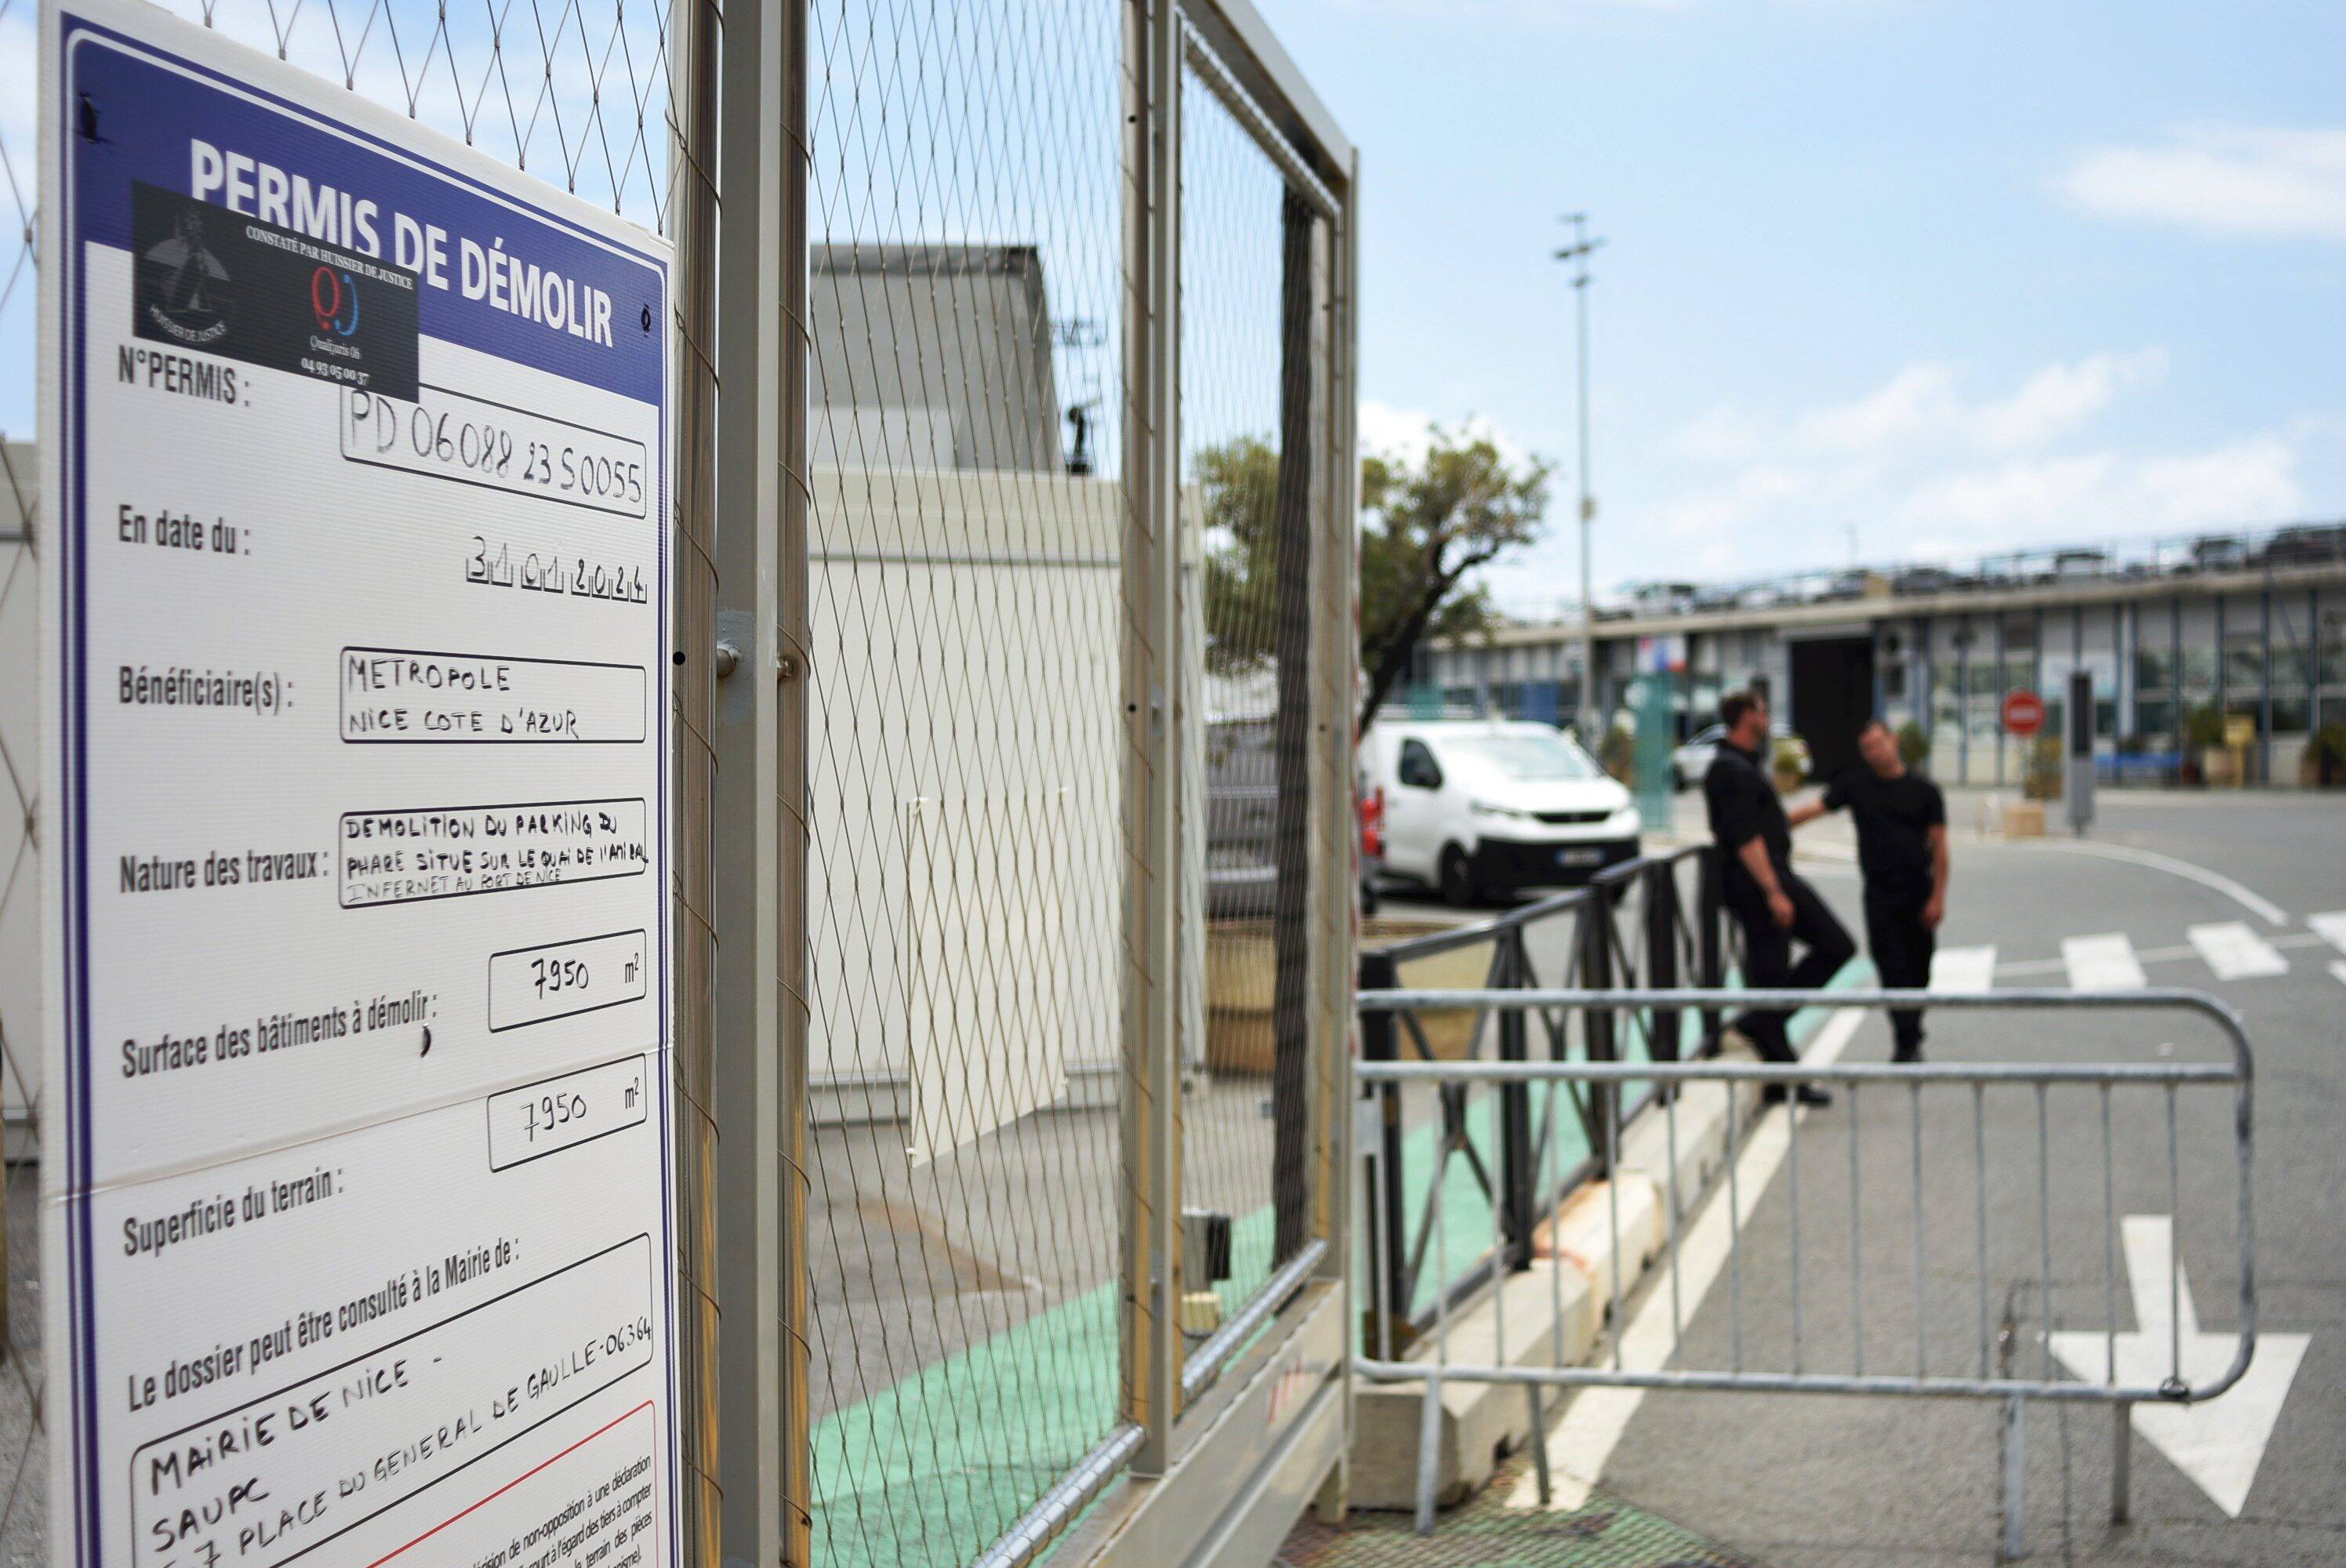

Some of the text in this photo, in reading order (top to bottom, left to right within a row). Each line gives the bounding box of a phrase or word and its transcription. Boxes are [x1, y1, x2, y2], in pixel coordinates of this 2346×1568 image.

[191, 138, 614, 348] PERMIS DE DÉMOLIR
[246, 225, 413, 290] CONSTATÉ PAR HUISSIER DE JUSTICE
[301, 358, 315, 373] 04
[316, 361, 329, 376] 93
[329, 365, 343, 380] 05
[343, 368, 357, 381] 00
[350, 390, 396, 452] PD
[411, 405, 513, 478] 06088
[118, 503, 147, 544] En
[156, 509, 204, 551] date
[212, 510, 237, 555] du
[118, 664, 281, 715] Bénéficiaire(s)
[347, 655, 511, 695] METROPOLE
[424, 710, 483, 732] COTE
[500, 706, 579, 739] D'AZUR
[485, 814, 507, 837] DU
[598, 812, 617, 834] DU
[119, 855, 195, 894] Nature
[202, 851, 240, 887] des
[247, 849, 319, 884] travaux
[347, 850, 405, 880] PHARE
[480, 850, 510, 871] SUR
[518, 848, 535, 869] LE
[576, 847, 594, 866] DE
[347, 868, 561, 903] INFERNET AU PORT DE NICE
[531, 957, 590, 1000] 7950
[122, 1036, 207, 1080] Surface
[215, 1025, 251, 1061] des
[257, 1007, 347, 1053] bâtiments
[352, 1001, 365, 1035] à
[368, 991, 429, 1030] démolir
[519, 1092, 587, 1142] 7950
[123, 1194, 234, 1257] Superficie
[242, 1188, 266, 1224] du
[271, 1167, 333, 1216] terrain
[129, 1372, 156, 1412] Le
[164, 1343, 245, 1399] dossier
[250, 1321, 292, 1375] peut
[297, 1312, 333, 1352] être
[338, 1274, 408, 1331] consulté
[412, 1271, 423, 1303] à
[427, 1266, 440, 1298] la
[445, 1246, 492, 1289] Mairie
[496, 1238, 511, 1267] de
[289, 1392, 331, 1431] DE
[239, 1490, 328, 1556] PLACE
[339, 1472, 365, 1499] DU
[373, 1409, 482, 1482] GENERAL
[493, 1386, 519, 1420] DE
[508, 1537, 521, 1560] de
[523, 1498, 585, 1551] non-opposition
[587, 1490, 593, 1508] à
[595, 1483, 610, 1503] une
[612, 1455, 651, 1491] déclaration
[586, 1519, 599, 1539] des
[600, 1509, 616, 1529] tiers
[616, 1500, 622, 1518] à
[623, 1483, 652, 1514] compter
[586, 1538, 611, 1568] terrain
[614, 1529, 627, 1548] des
[631, 1511, 652, 1542] pièces
